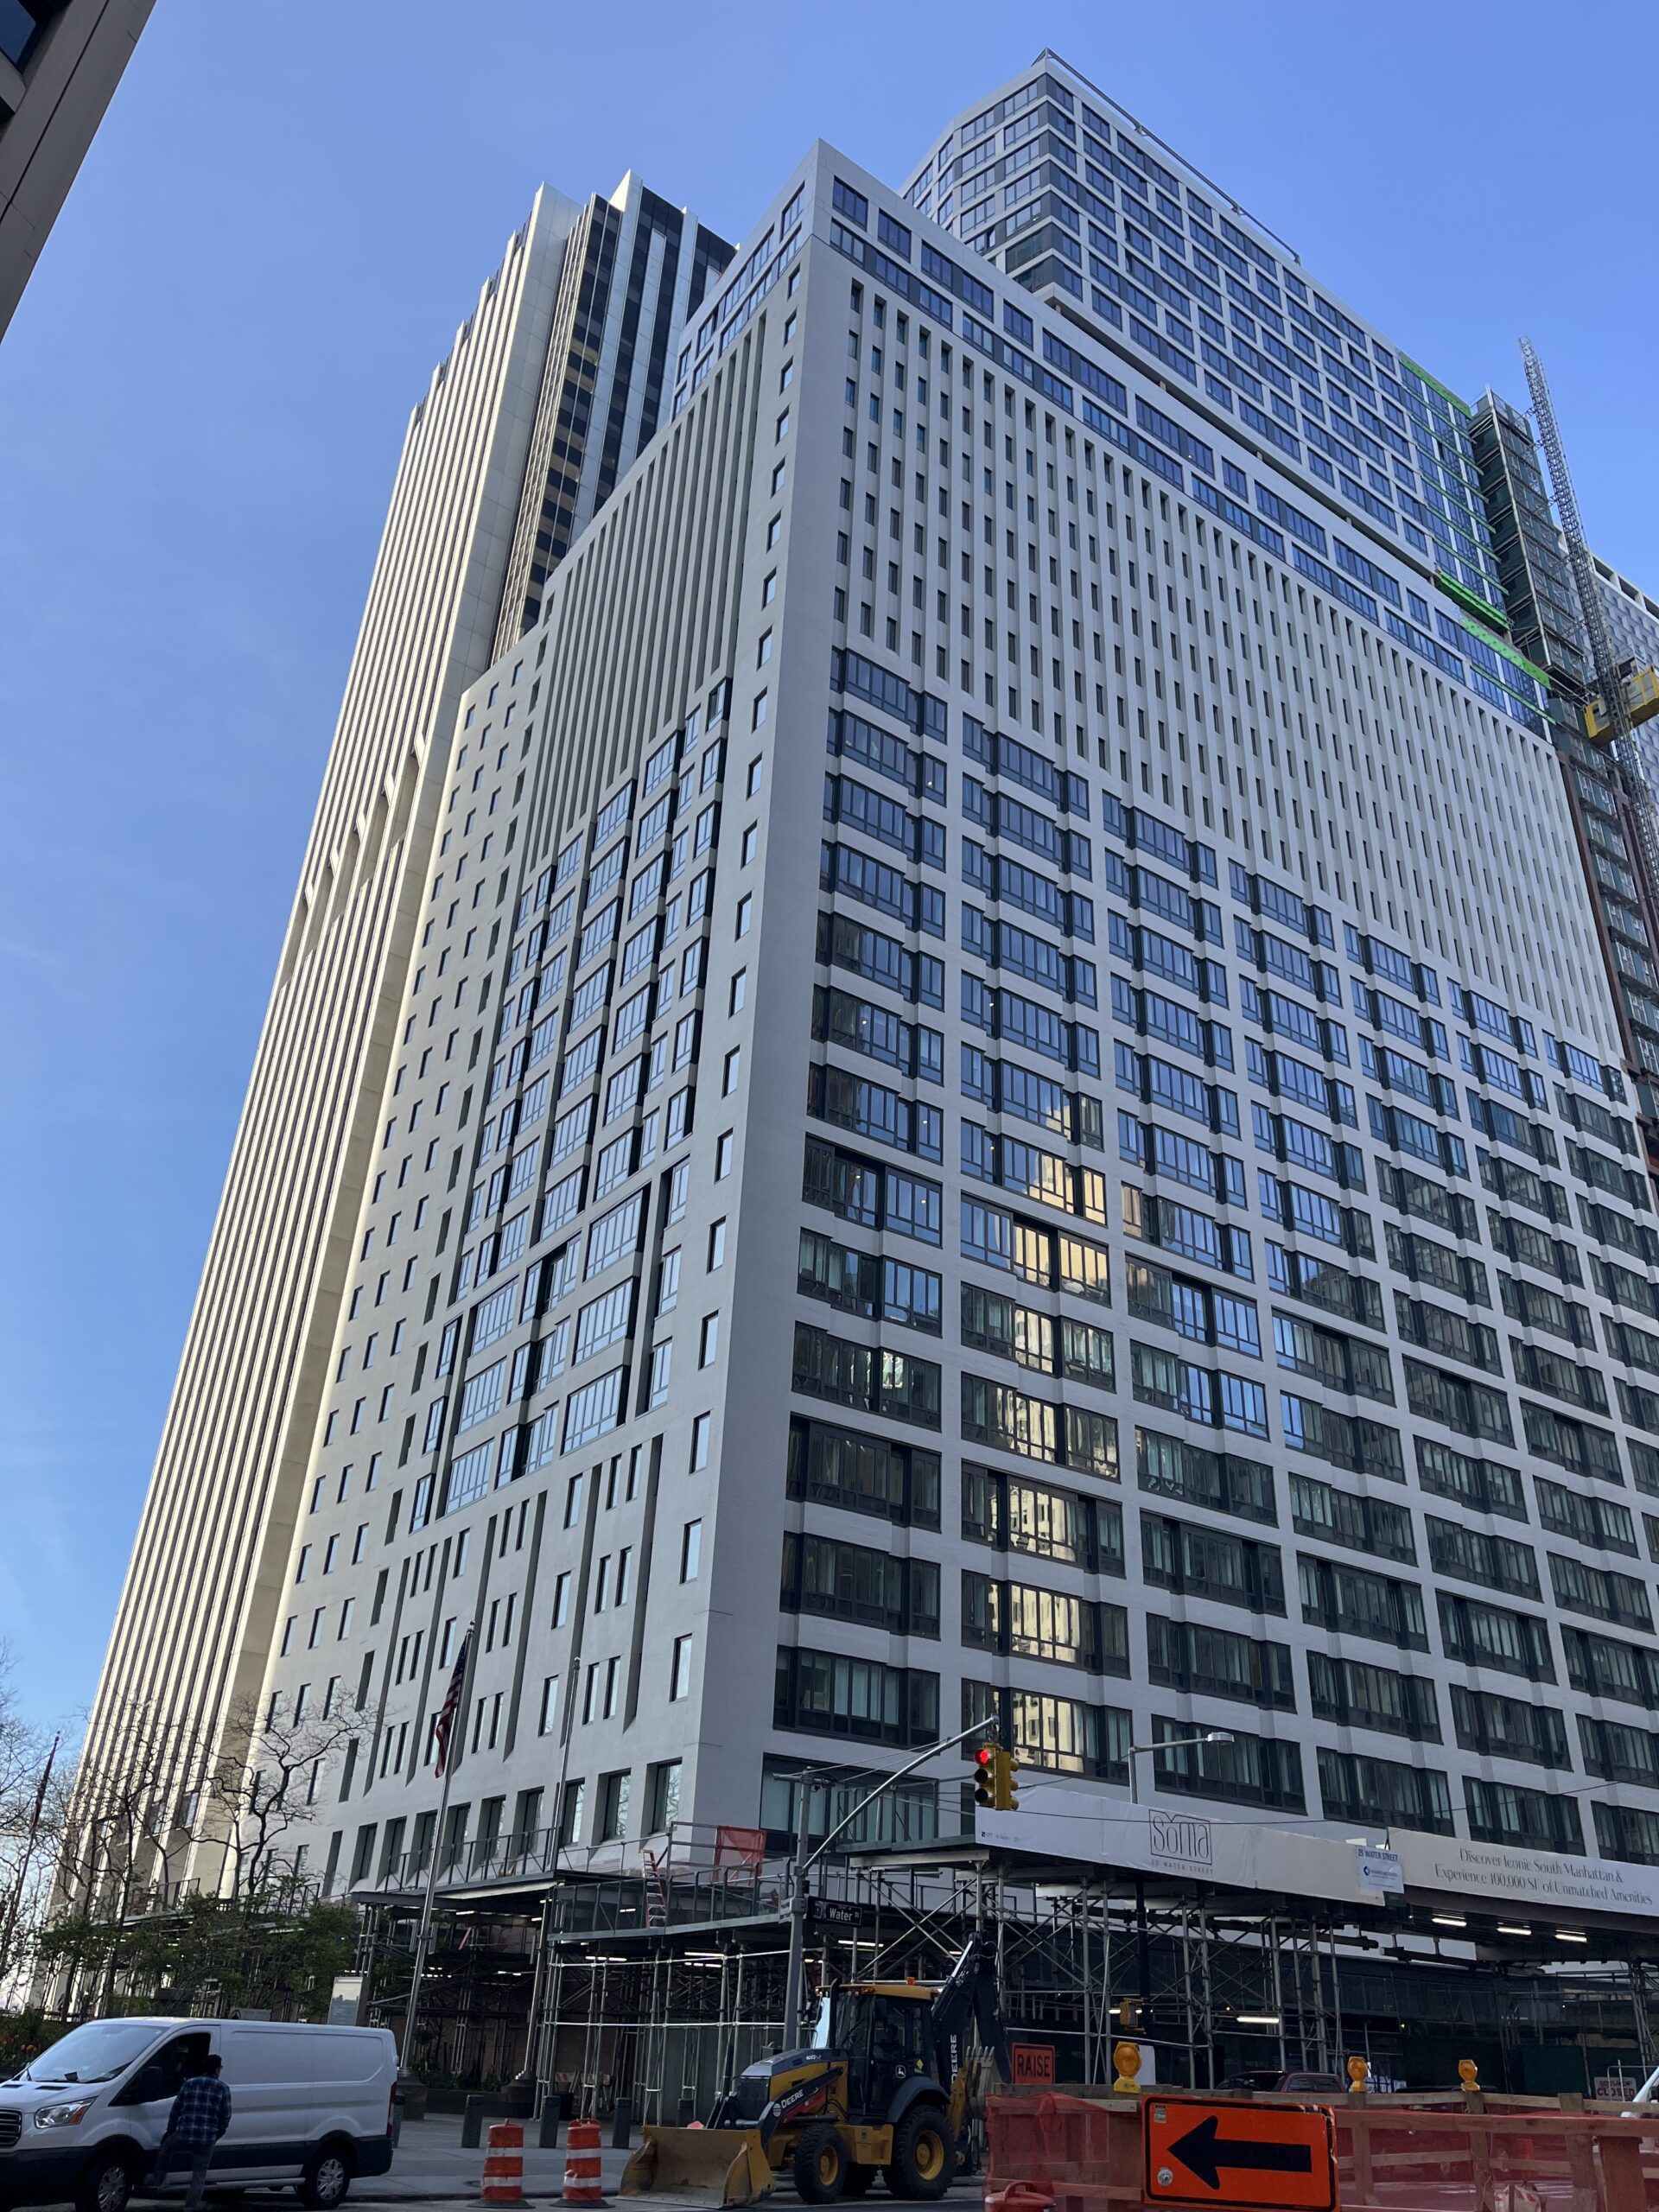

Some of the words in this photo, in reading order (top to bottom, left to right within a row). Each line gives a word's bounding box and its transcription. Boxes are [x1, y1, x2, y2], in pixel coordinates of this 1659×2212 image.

[1364, 1850, 1382, 1859] WATER
[1382, 1853, 1398, 1862] STREET
[1459, 1847, 1502, 1866] Discover
[1503, 1854, 1532, 1872] Iconic
[1533, 1859, 1562, 1875] South
[1563, 1863, 1614, 1882] Manhattan
[1615, 1870, 1624, 1883] &
[1435, 1863, 1487, 1884] Experience
[1528, 1878, 1538, 1891] SF
[1542, 1881, 1553, 1893] of
[1554, 1880, 1607, 1900] Unmatched
[1611, 1887, 1653, 1905] Amenities
[830, 1907, 853, 1922] Water
[1017, 2054, 1051, 2077] RAISE
[781, 2088, 804, 2109] DEERE
[1597, 2088, 1636, 2098] CLOSED
